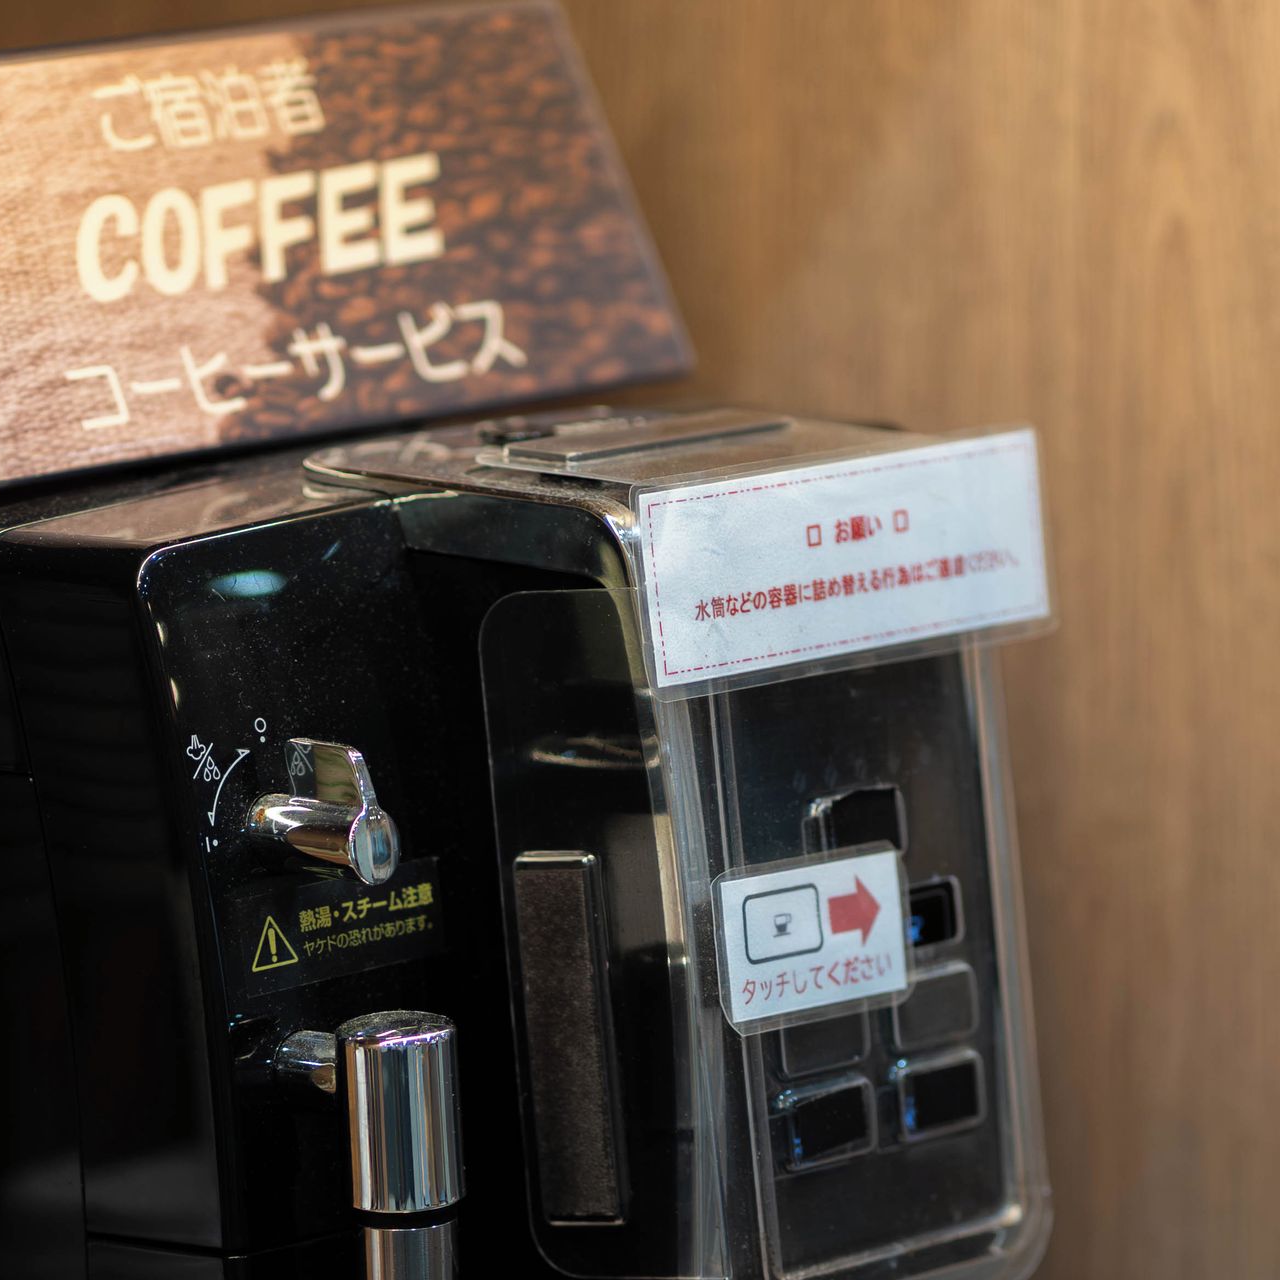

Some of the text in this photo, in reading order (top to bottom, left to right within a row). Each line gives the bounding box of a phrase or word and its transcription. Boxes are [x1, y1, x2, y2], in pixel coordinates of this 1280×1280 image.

[92, 58, 326, 151] ご宿泊者
[74, 152, 444, 302] COFFEE
[65, 300, 527, 430] コーヒーサービス
[299, 883, 433, 931] 熱湯・スチーム注意
[304, 915, 433, 956] ヤケドの恐れがあります。
[742, 954, 893, 1005] タッチしてください
